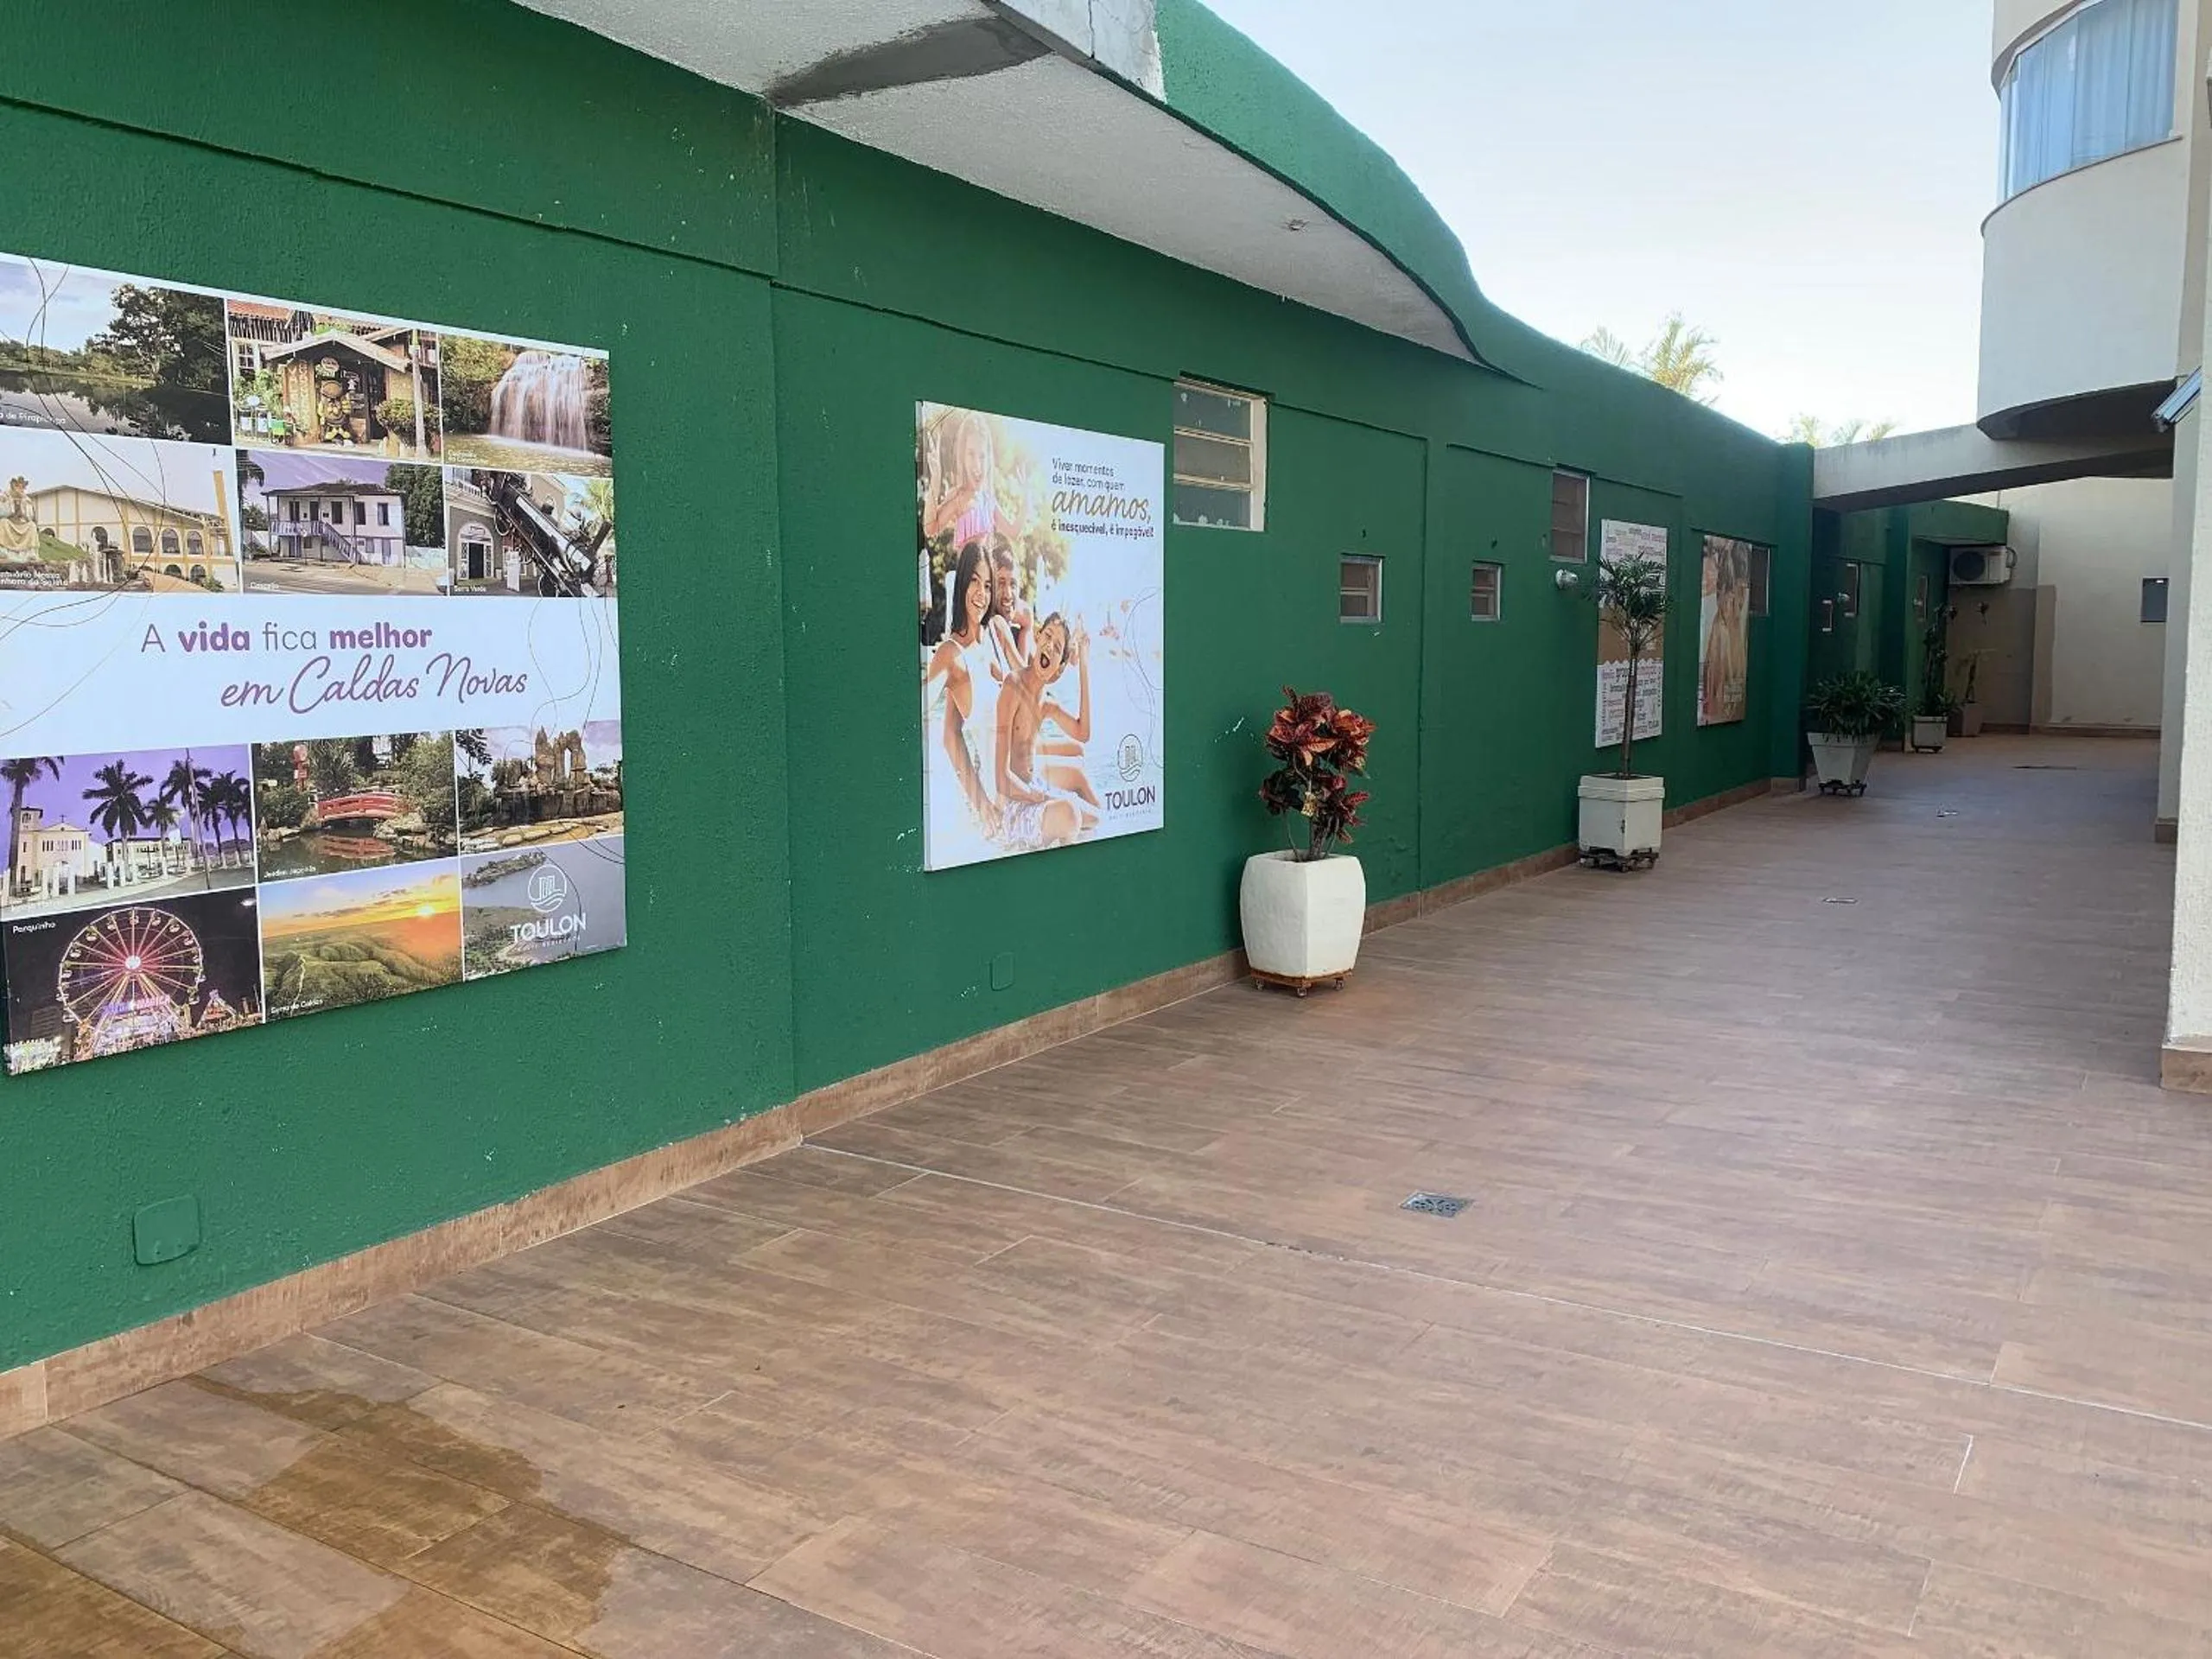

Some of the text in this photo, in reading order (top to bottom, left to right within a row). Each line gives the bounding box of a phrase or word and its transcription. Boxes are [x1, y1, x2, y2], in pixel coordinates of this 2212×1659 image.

[1052, 458, 1114, 477] Viver momentos
[1052, 473, 1062, 484] de
[1052, 489, 1151, 524] amamos,
[141, 620, 433, 653] A vida fica melhor
[220, 652, 527, 715] em Caldas Novas
[1105, 785, 1156, 811] TOULON
[12, 920, 57, 934] Parquinho
[510, 912, 587, 944] TOULON
